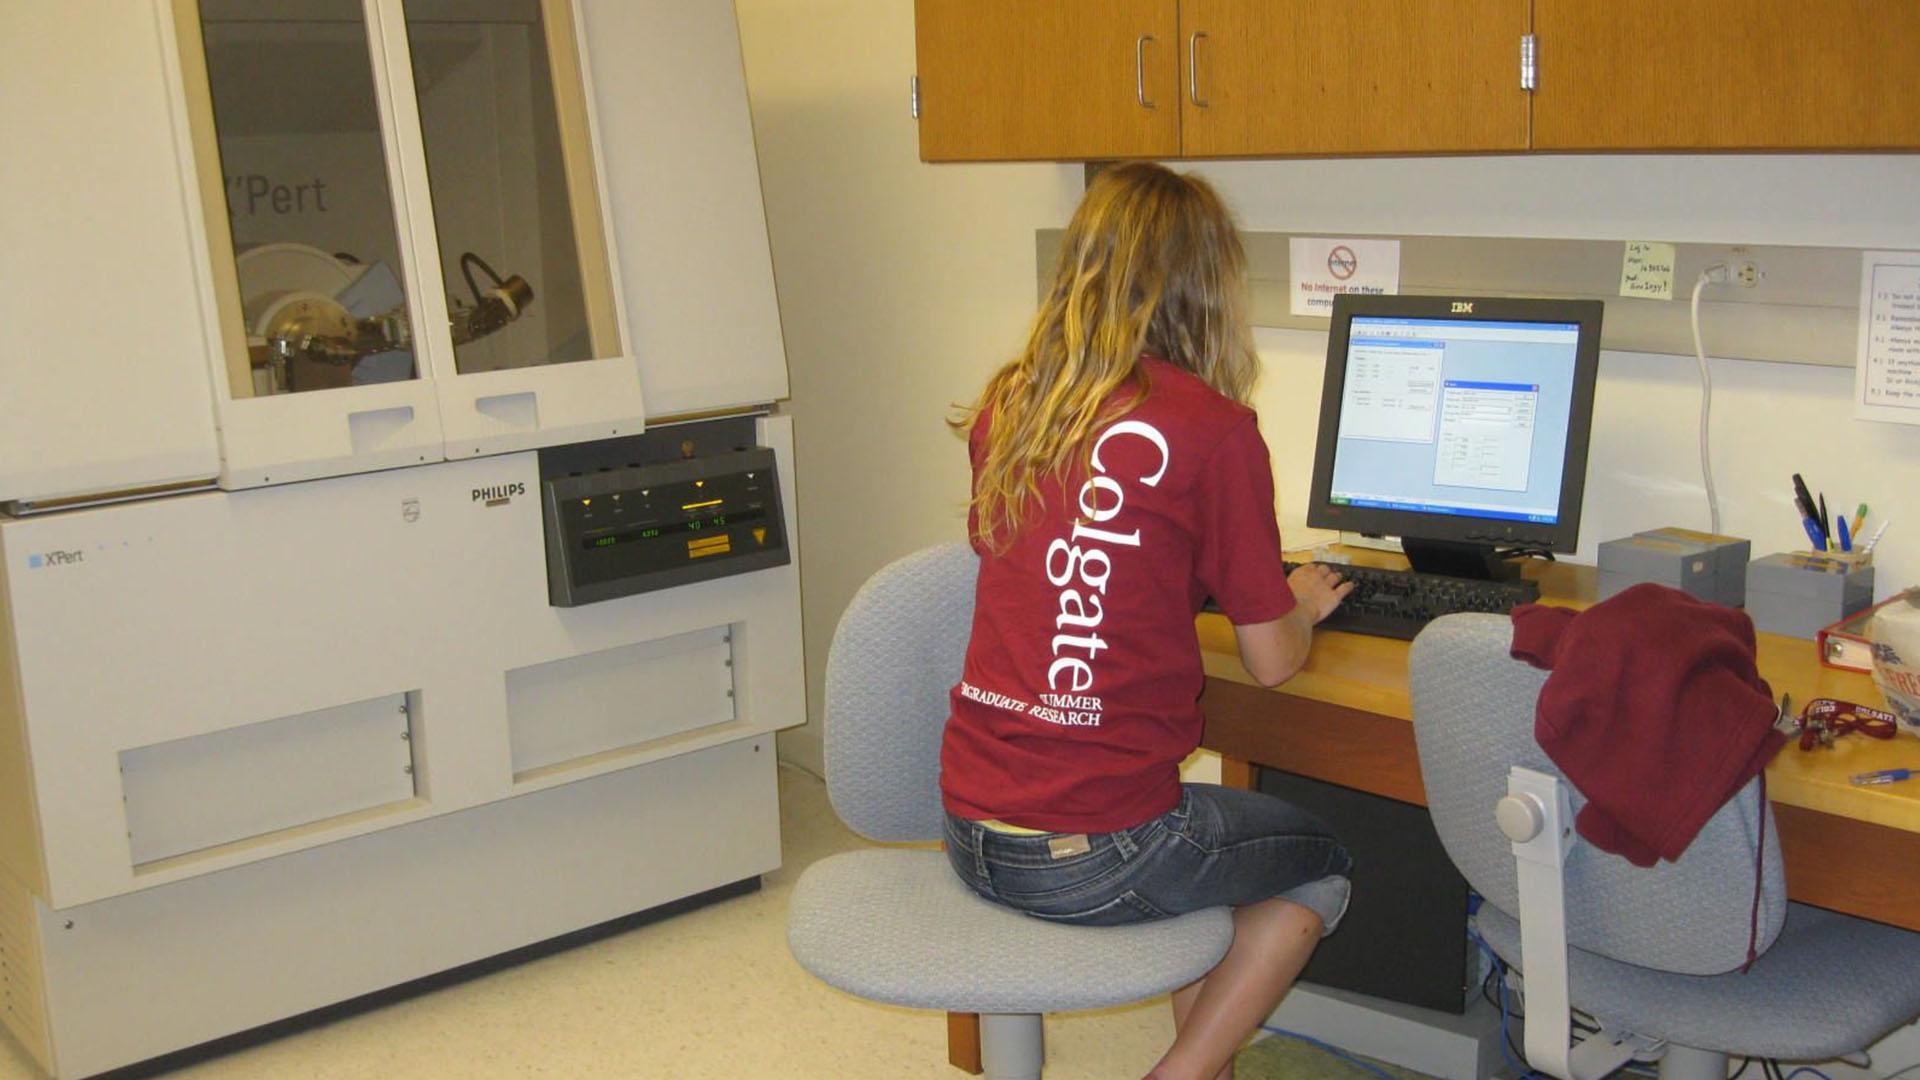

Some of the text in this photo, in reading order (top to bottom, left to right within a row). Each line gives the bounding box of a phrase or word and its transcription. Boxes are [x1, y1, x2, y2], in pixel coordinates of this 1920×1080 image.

[225, 173, 328, 214] 'Pert
[1451, 302, 1473, 313] IBM
[472, 482, 526, 502] PHILIPS
[1046, 420, 1169, 692] Colgate
[1039, 693, 1103, 711] UMMER
[1028, 705, 1101, 727] RESEARCH
